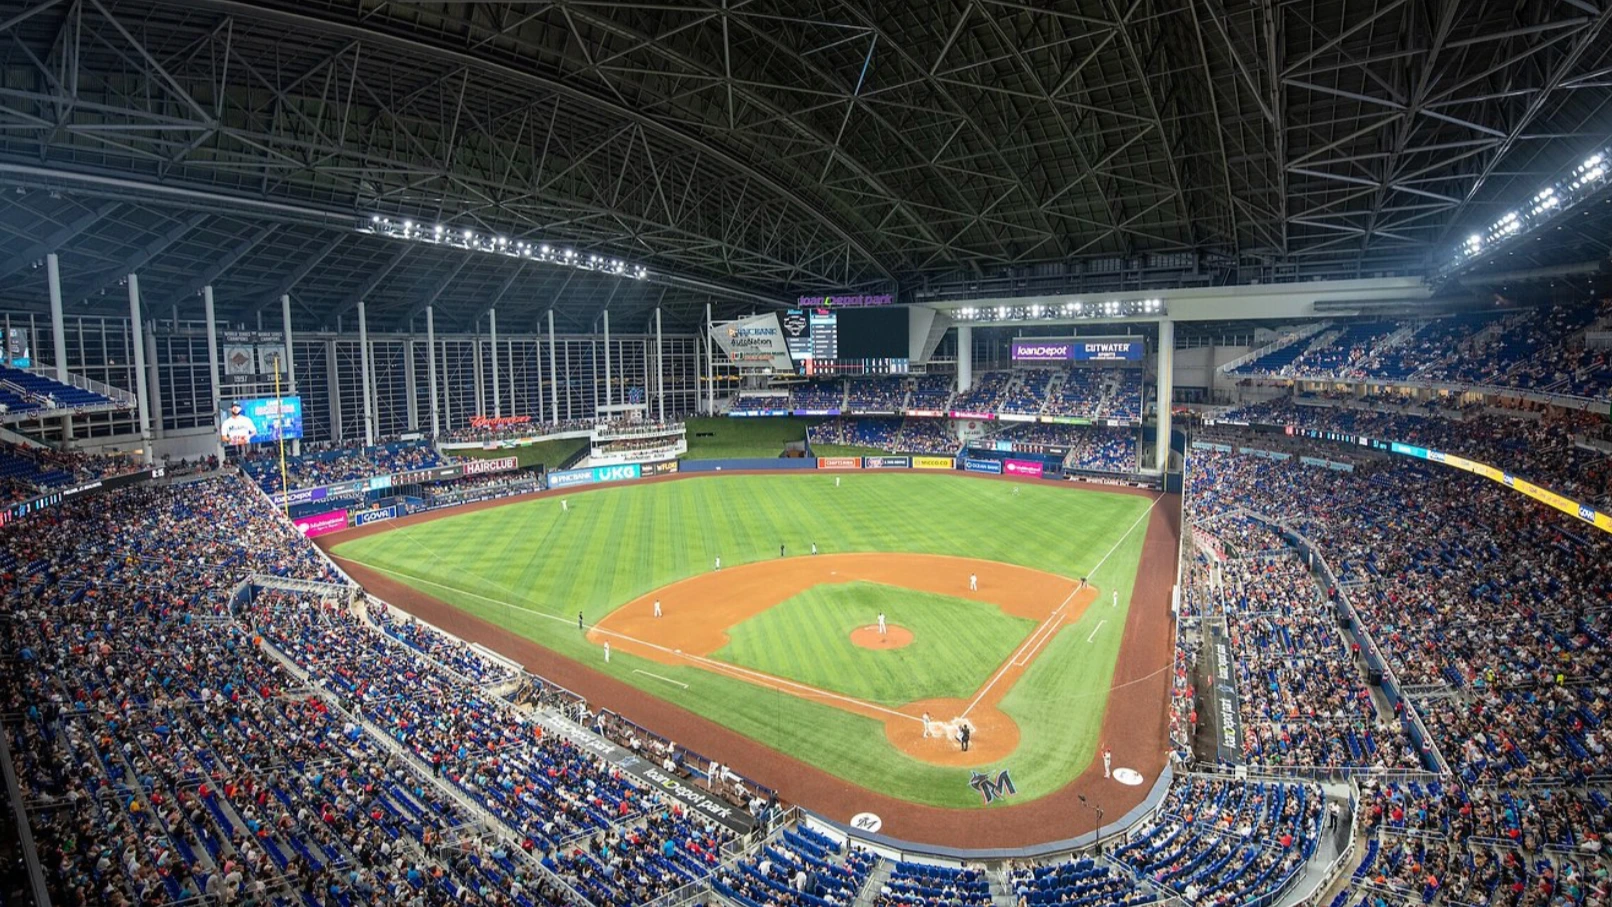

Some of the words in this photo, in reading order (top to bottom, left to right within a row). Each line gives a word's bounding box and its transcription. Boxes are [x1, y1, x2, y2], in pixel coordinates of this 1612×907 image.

[864, 294, 893, 305] park
[1017, 345, 1068, 357] loanDepot
[1085, 343, 1130, 353] CUTWATER
[466, 459, 514, 474] HAIRCLUB
[598, 466, 635, 481] UKG
[363, 511, 390, 523] GOYA
[642, 767, 706, 804] loanDepot
[695, 799, 733, 819] park
